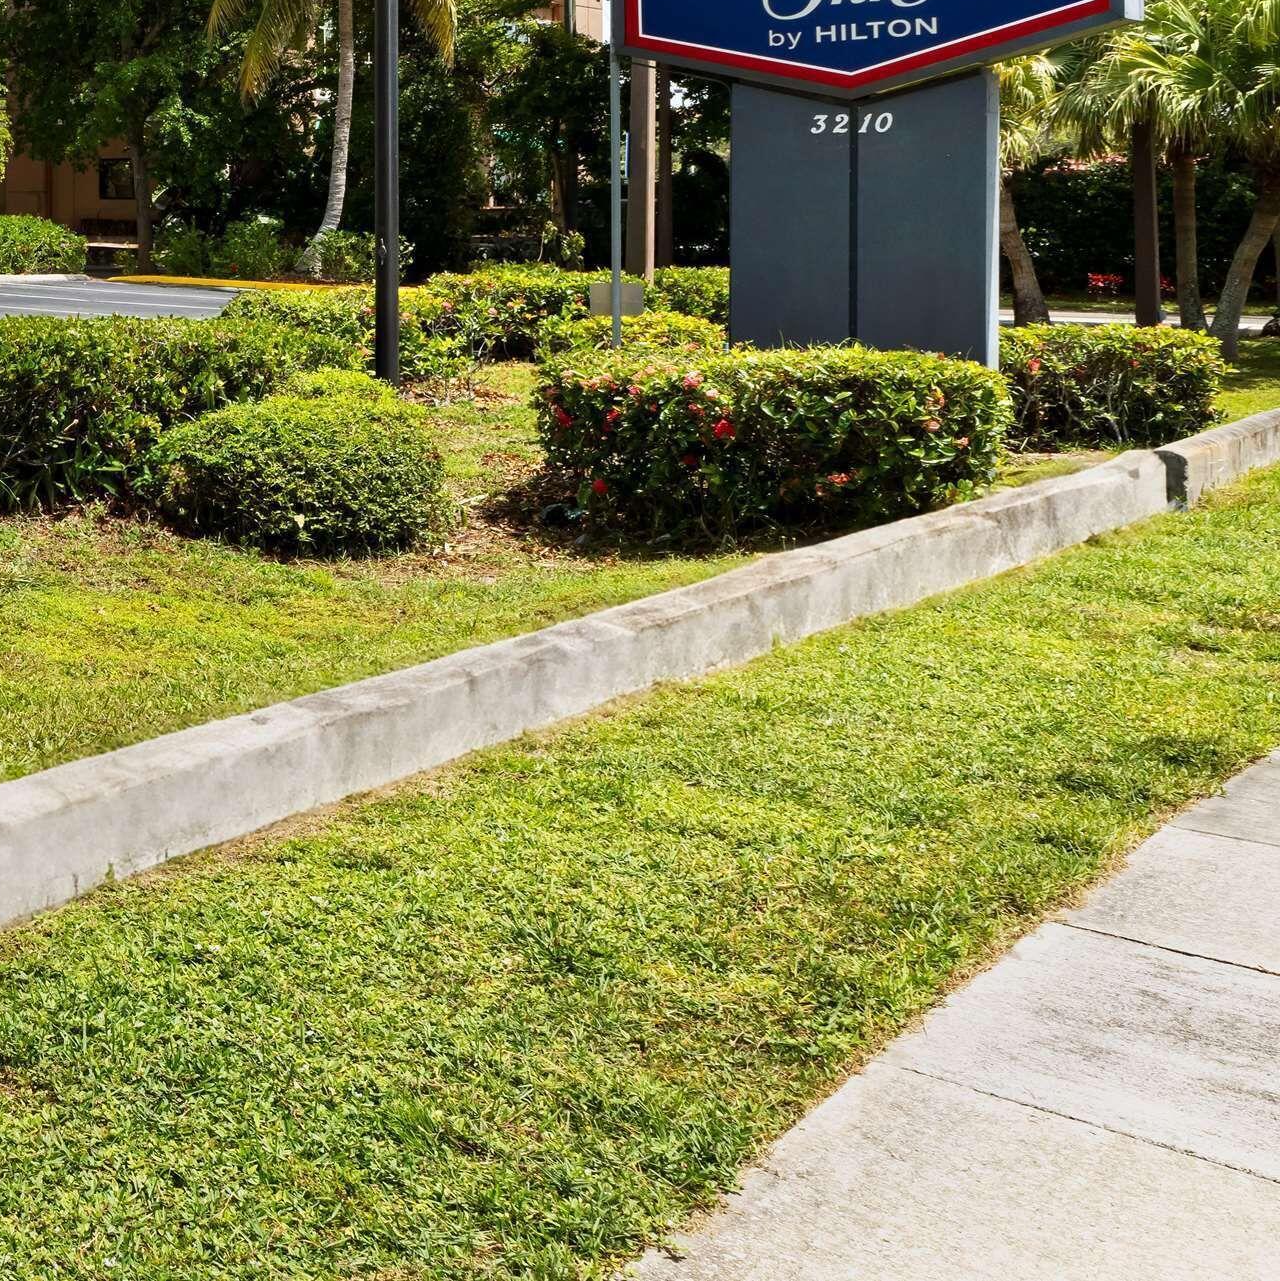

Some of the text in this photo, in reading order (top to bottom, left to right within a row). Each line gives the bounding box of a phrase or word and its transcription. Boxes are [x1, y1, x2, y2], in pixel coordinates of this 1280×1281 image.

[768, 17, 938, 50] by HILTON
[810, 112, 893, 134] 3210
